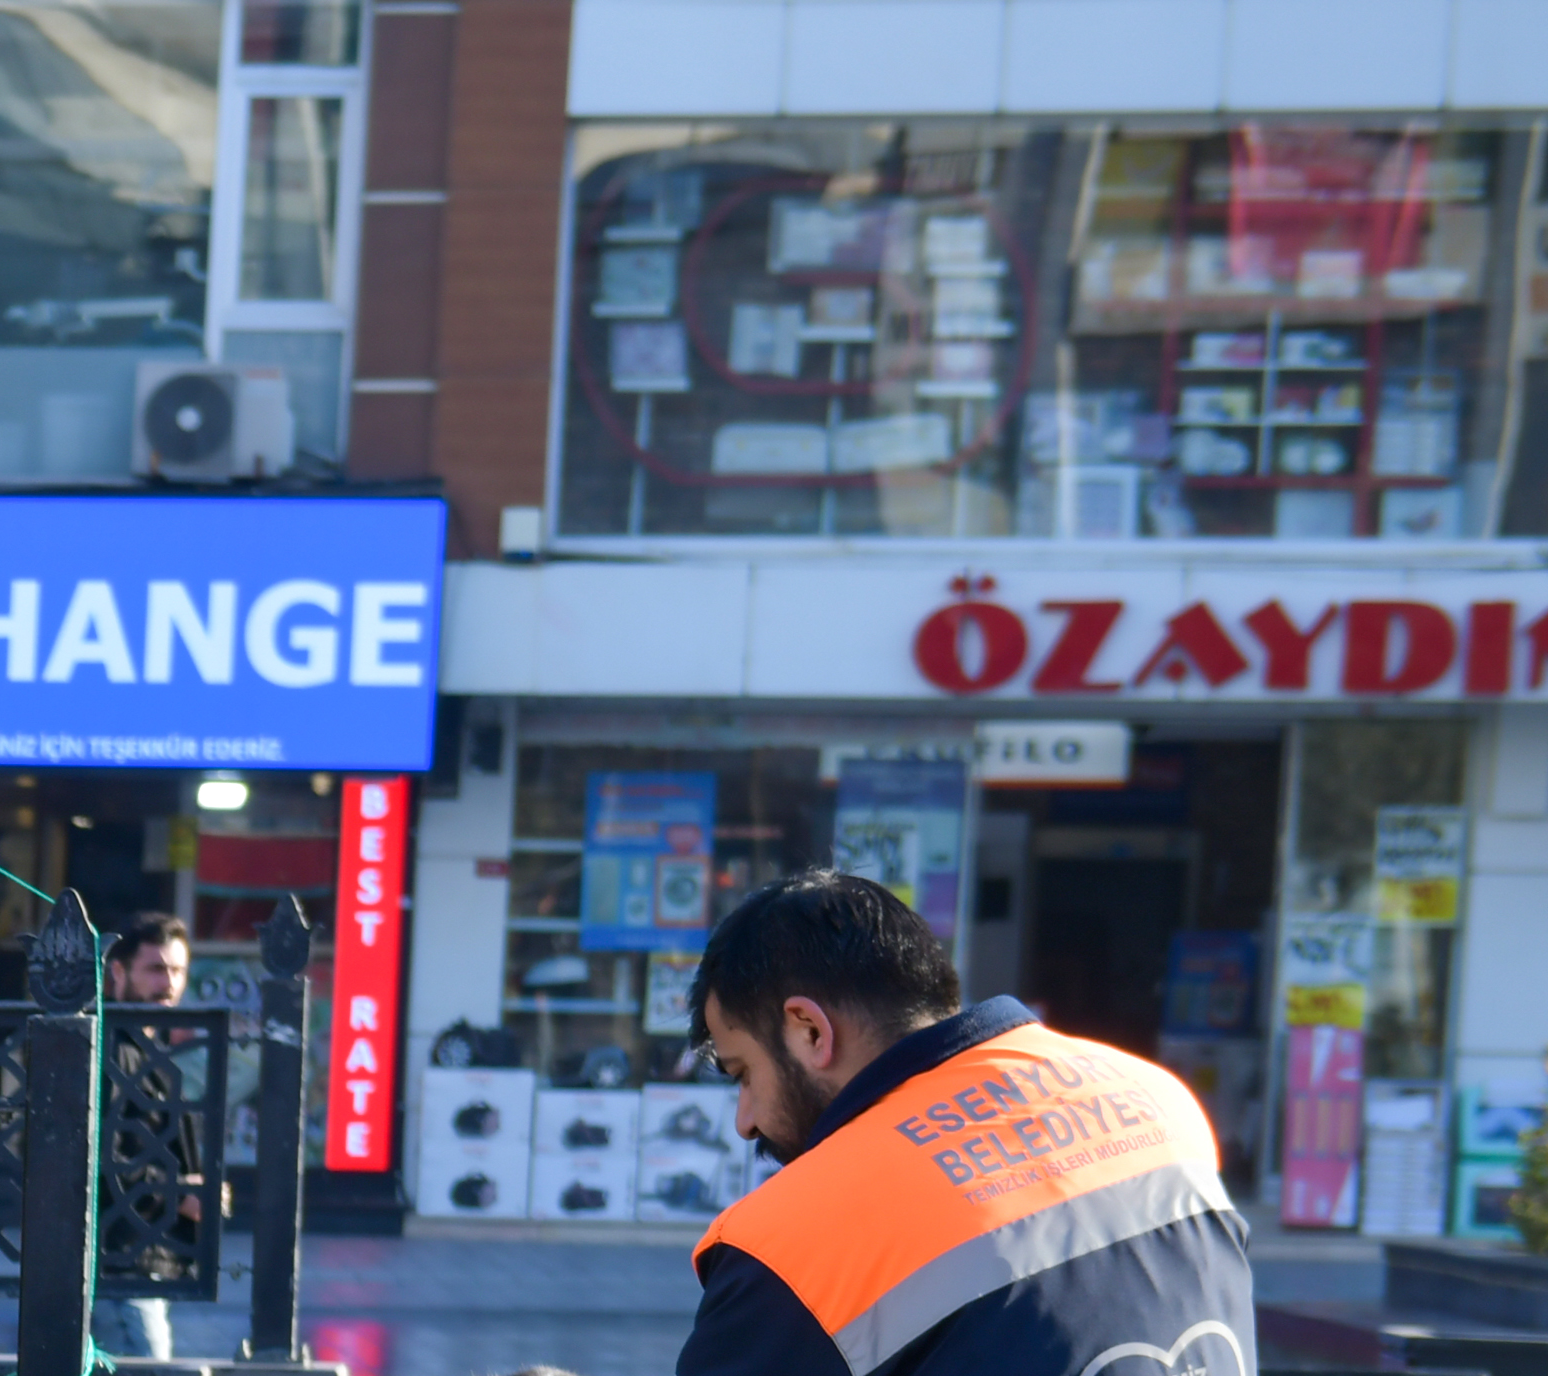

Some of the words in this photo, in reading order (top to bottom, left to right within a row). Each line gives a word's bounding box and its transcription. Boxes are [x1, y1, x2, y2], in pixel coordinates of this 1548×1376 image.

[353, 784, 390, 947] BEST
[346, 995, 380, 1158] RATE
[894, 1054, 1127, 1147] ESENYURT
[931, 1081, 1170, 1186] BELEDİYESİ
